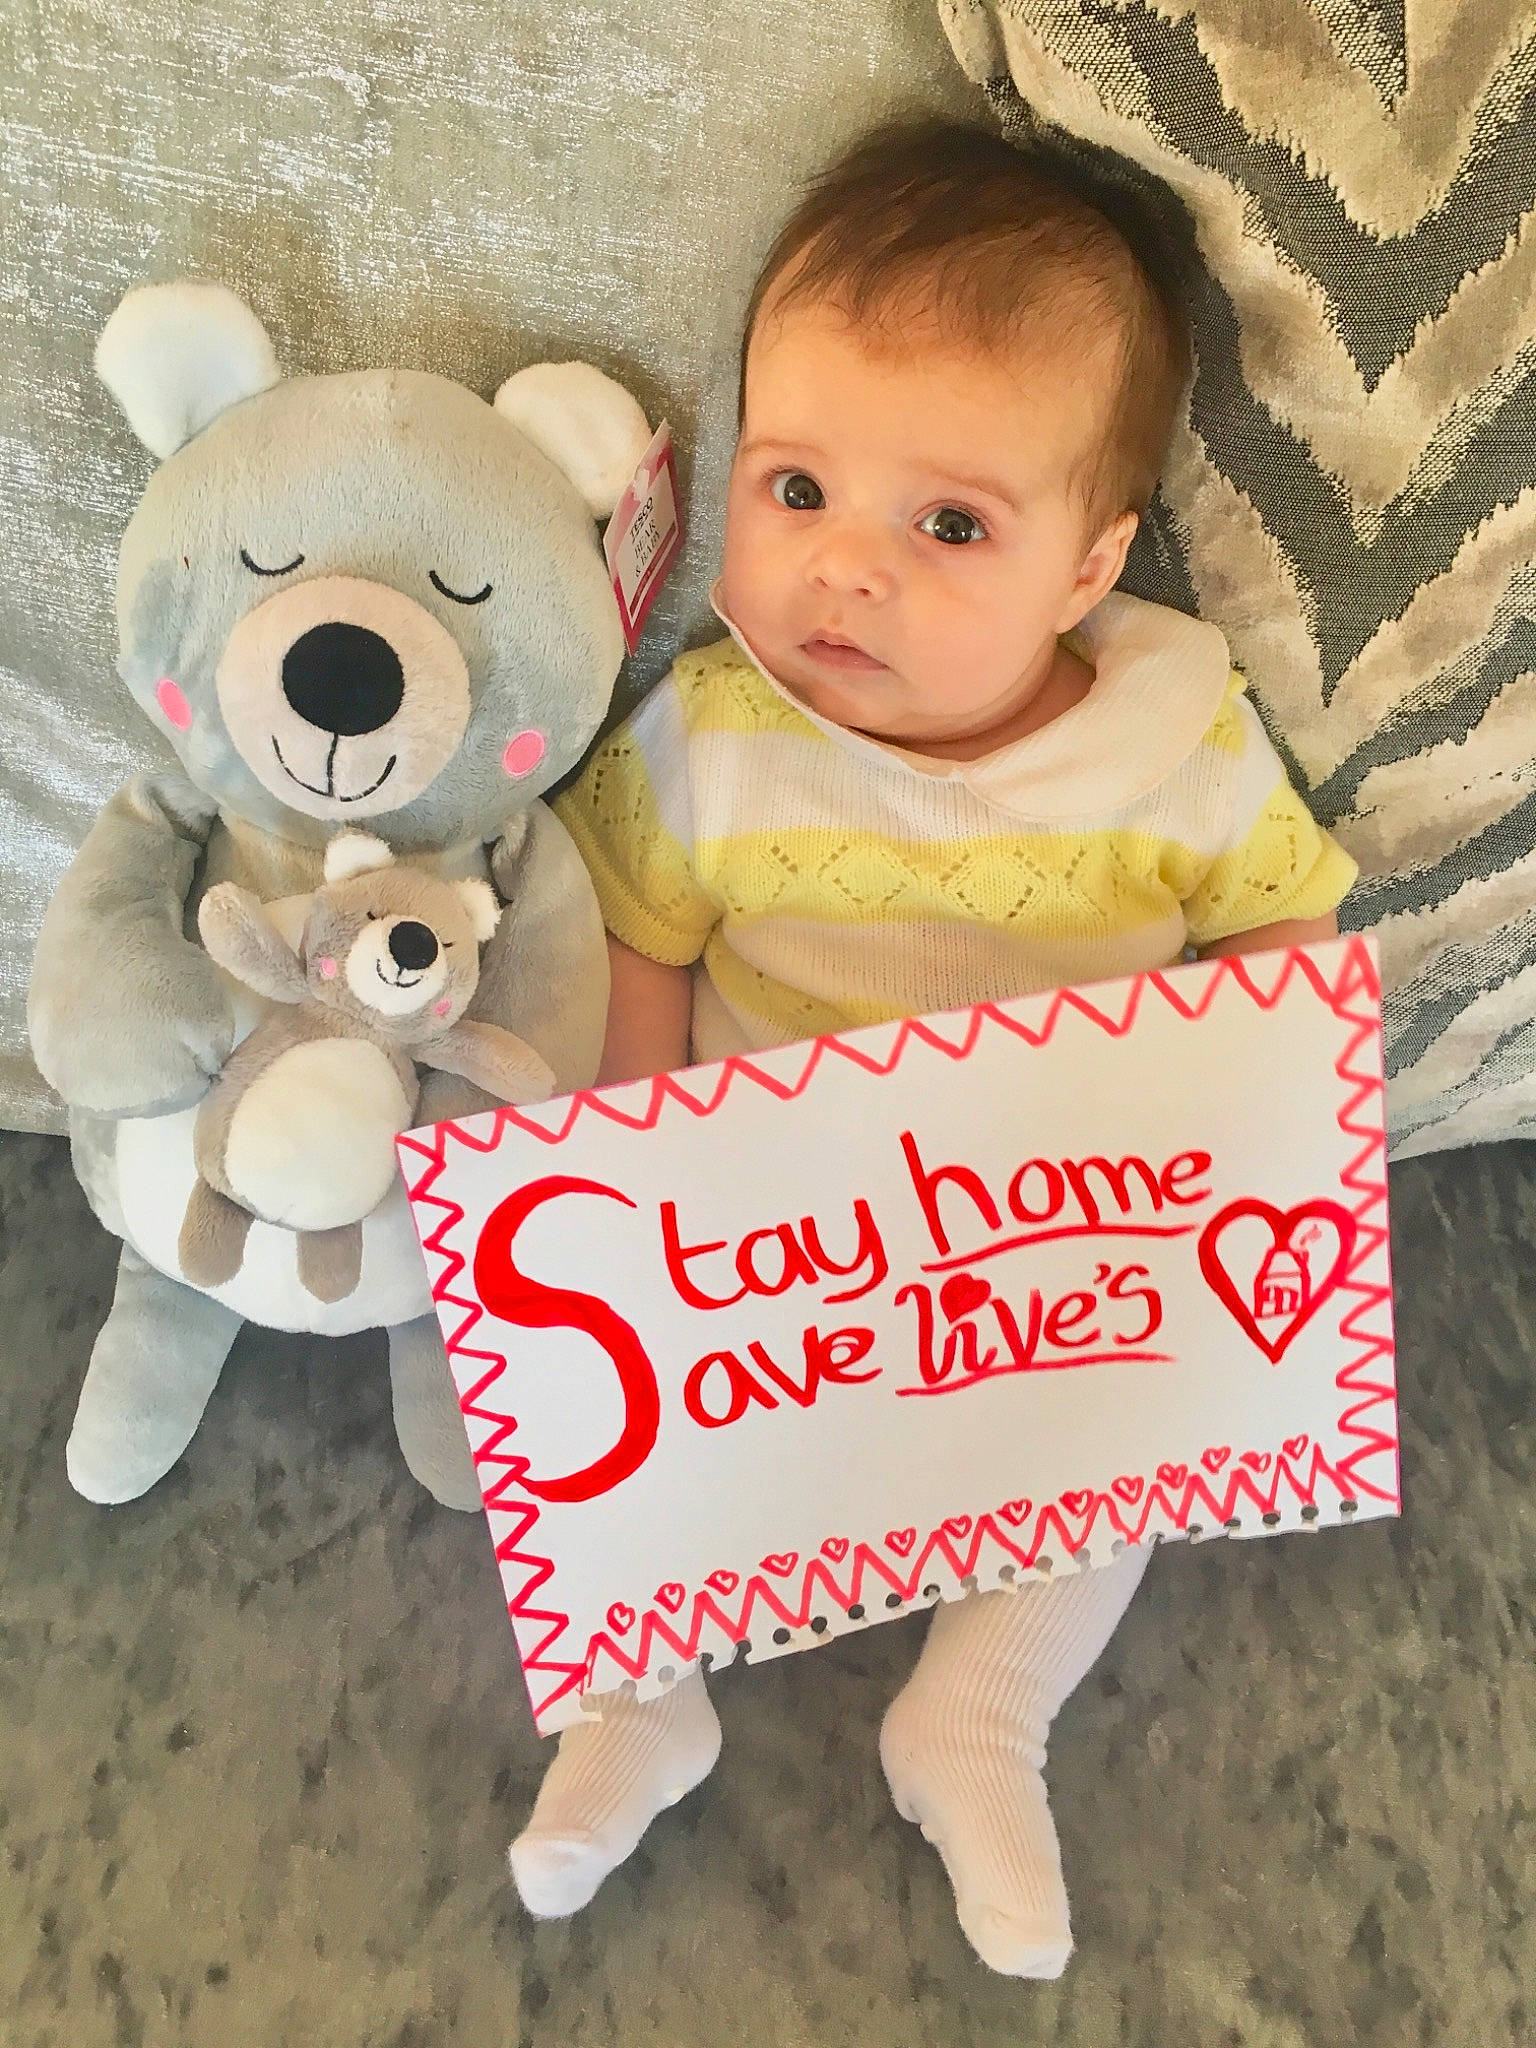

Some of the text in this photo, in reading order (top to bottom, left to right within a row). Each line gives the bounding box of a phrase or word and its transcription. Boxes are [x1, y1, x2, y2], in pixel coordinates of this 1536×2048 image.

[630, 496, 653, 539] TESCO
[898, 1129, 1213, 1259] home
[893, 1261, 1165, 1387] live's
